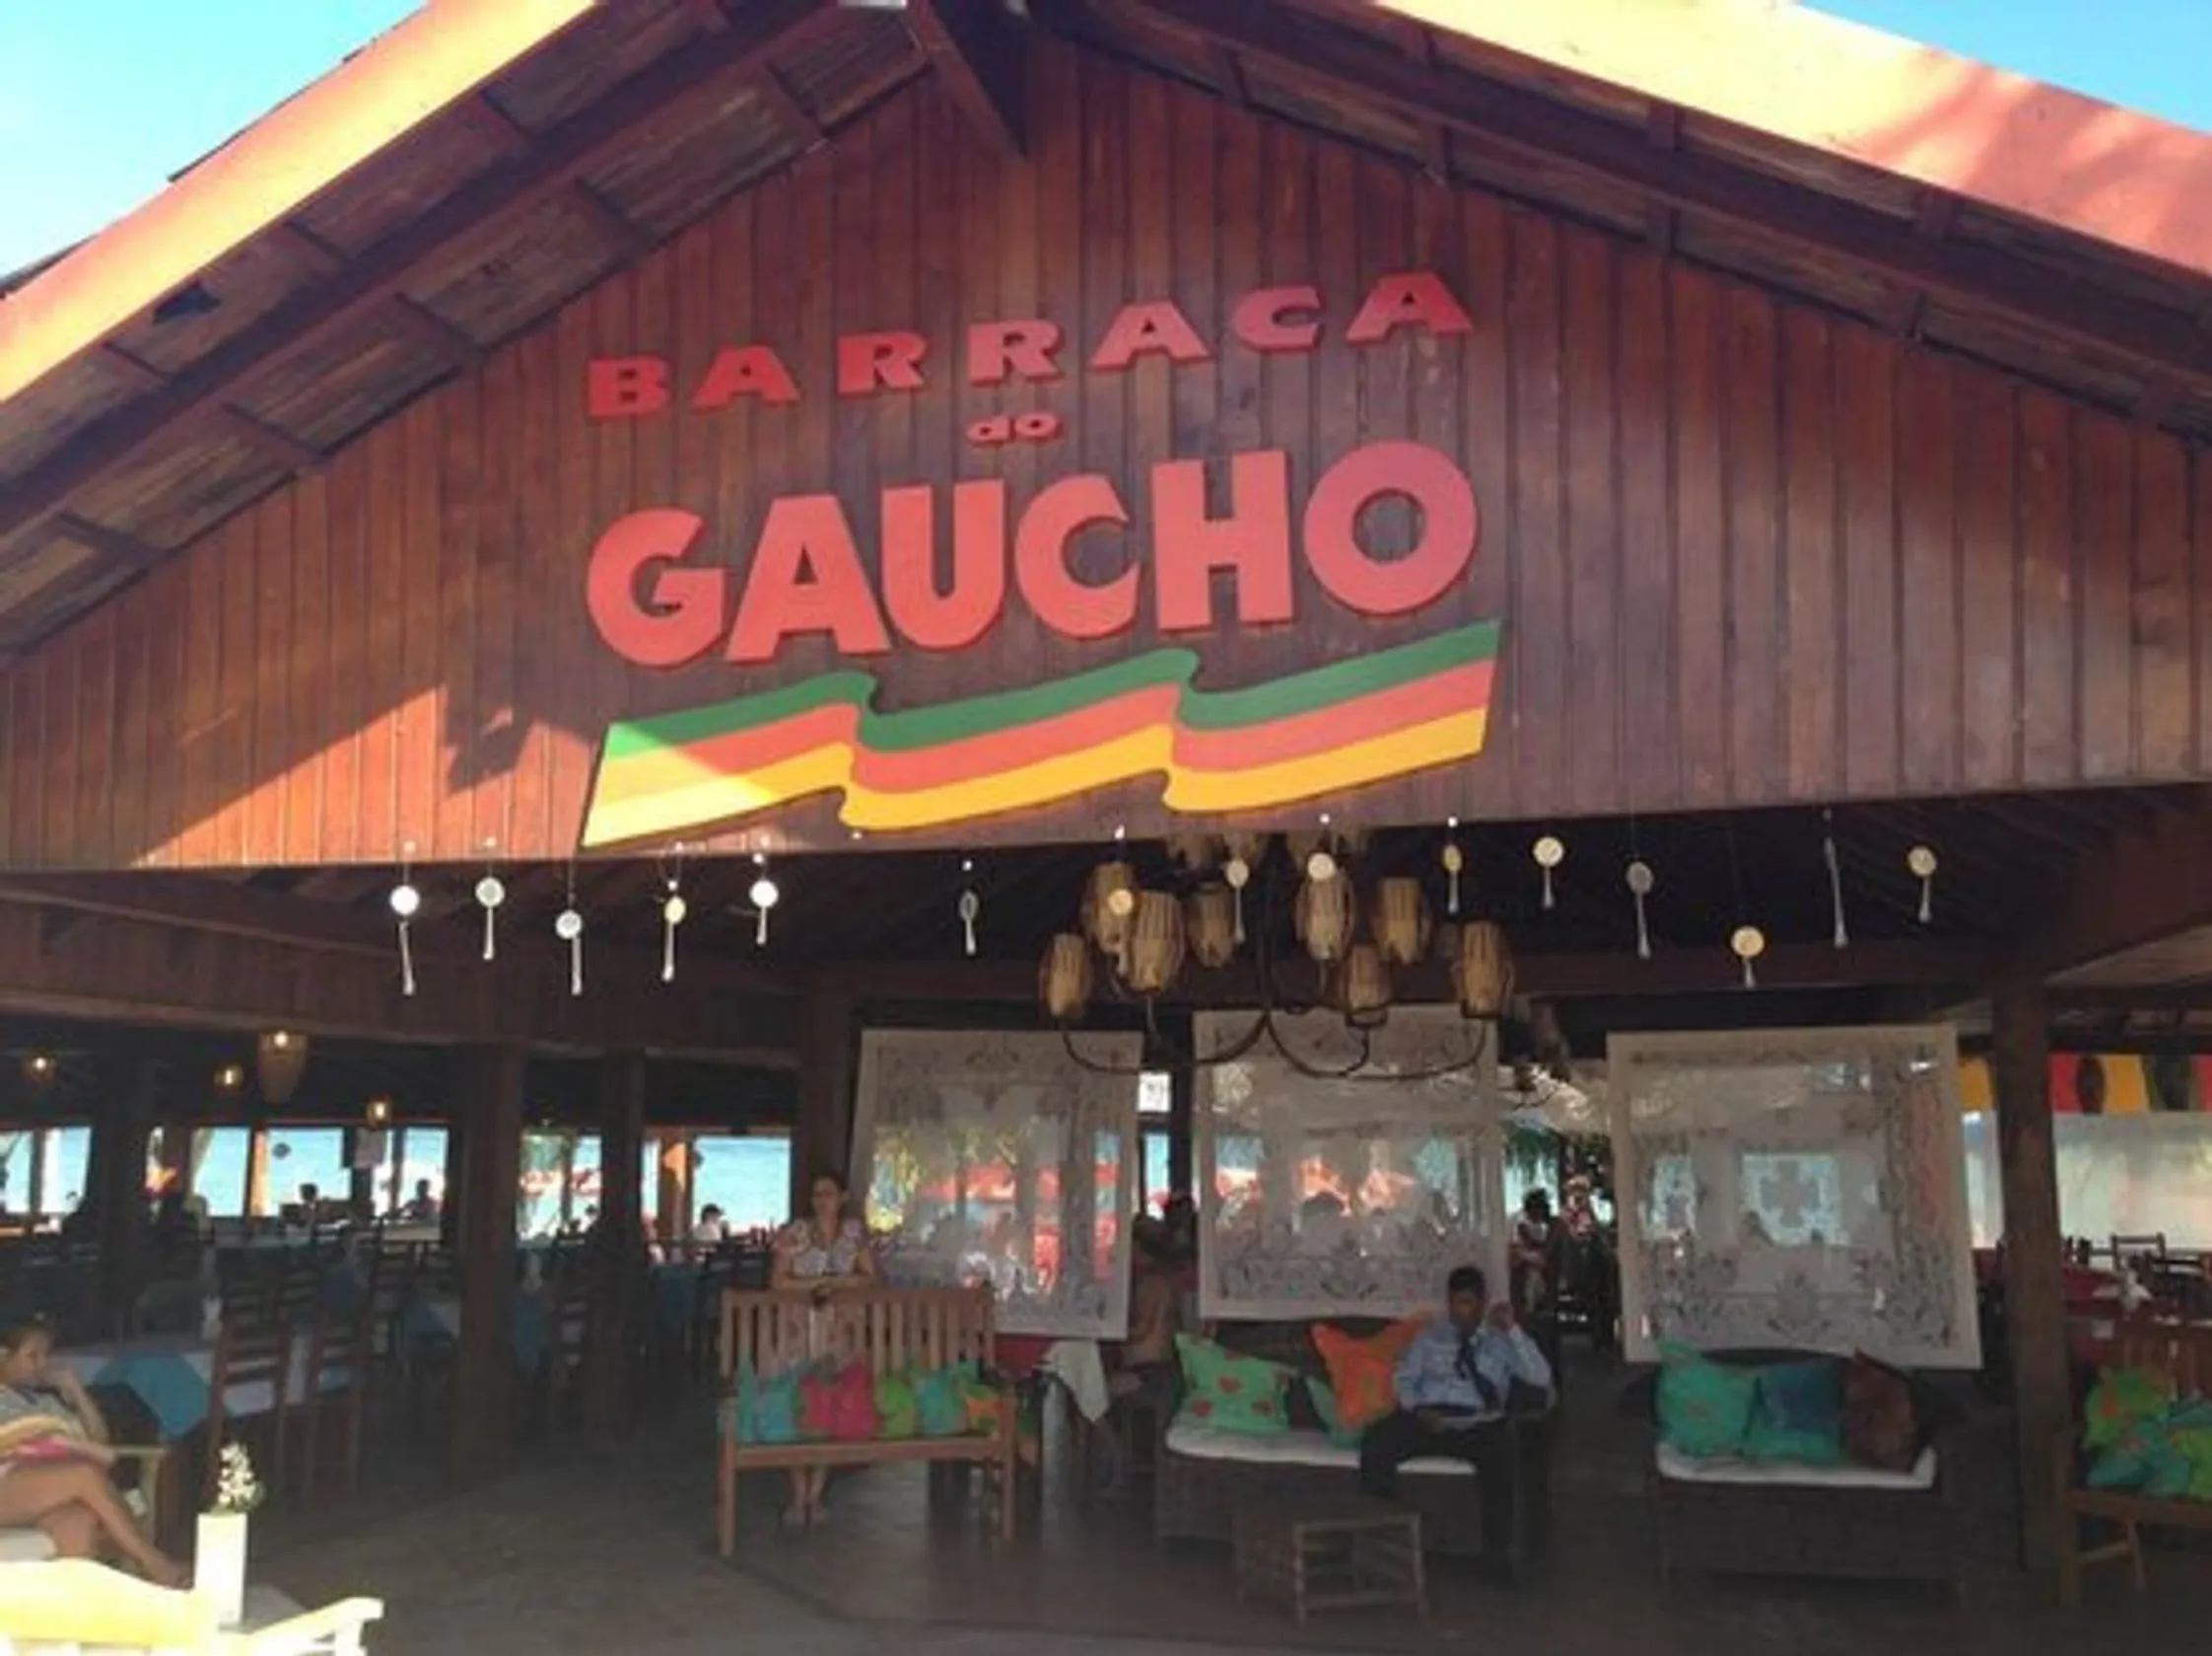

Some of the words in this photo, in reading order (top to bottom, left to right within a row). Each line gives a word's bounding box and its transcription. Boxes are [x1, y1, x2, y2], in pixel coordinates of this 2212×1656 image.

[587, 270, 1474, 418] BARRACA
[966, 410, 1061, 446] do
[586, 441, 1481, 667] GAUCHO
